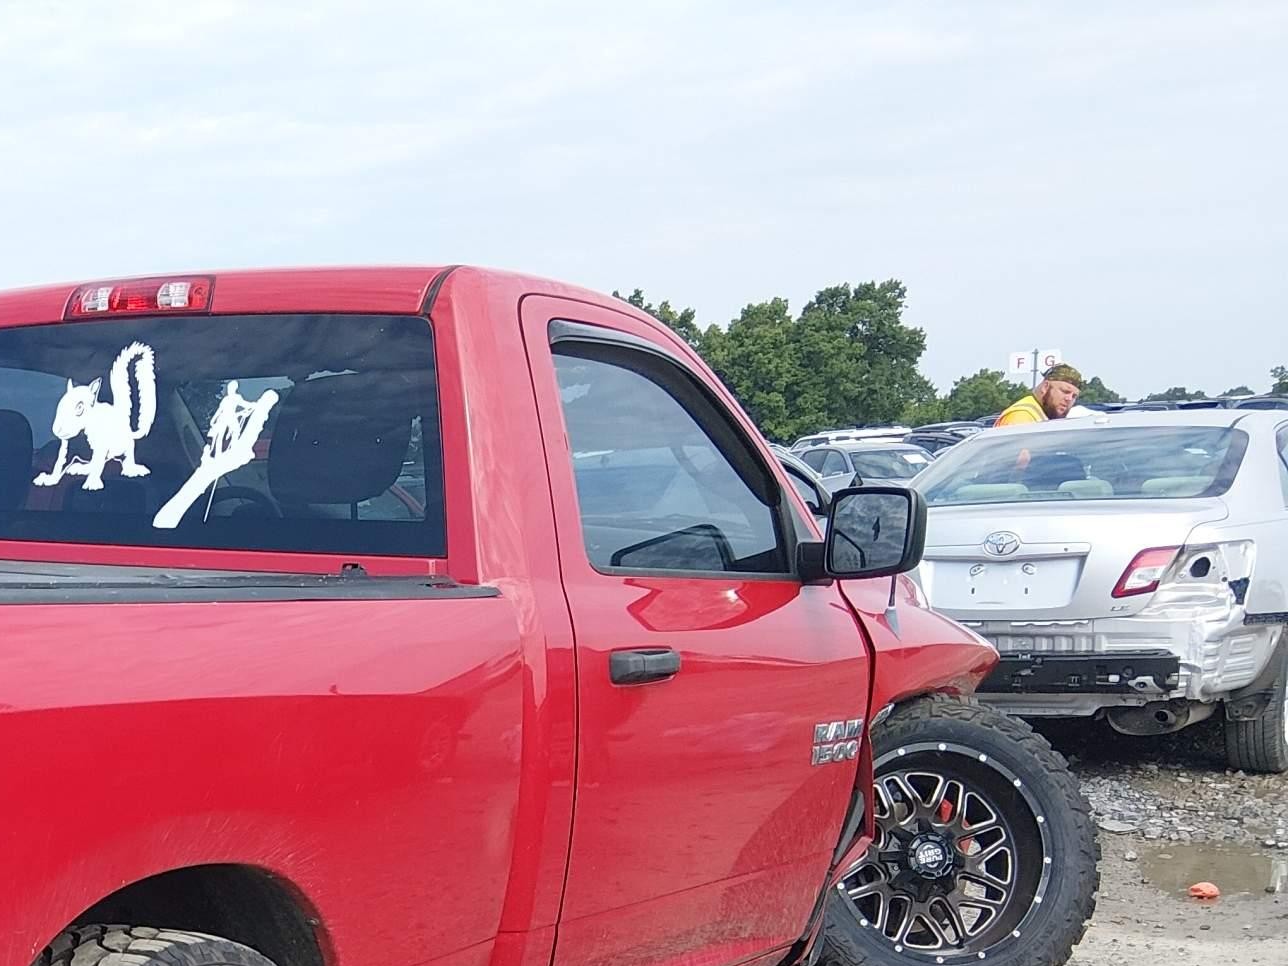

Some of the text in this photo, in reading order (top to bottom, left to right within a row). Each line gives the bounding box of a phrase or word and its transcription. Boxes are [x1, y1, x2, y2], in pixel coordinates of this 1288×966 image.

[1016, 357, 1025, 369] F
[1044, 355, 1056, 367] G
[814, 719, 864, 743] RAM
[811, 740, 858, 765] 1500
